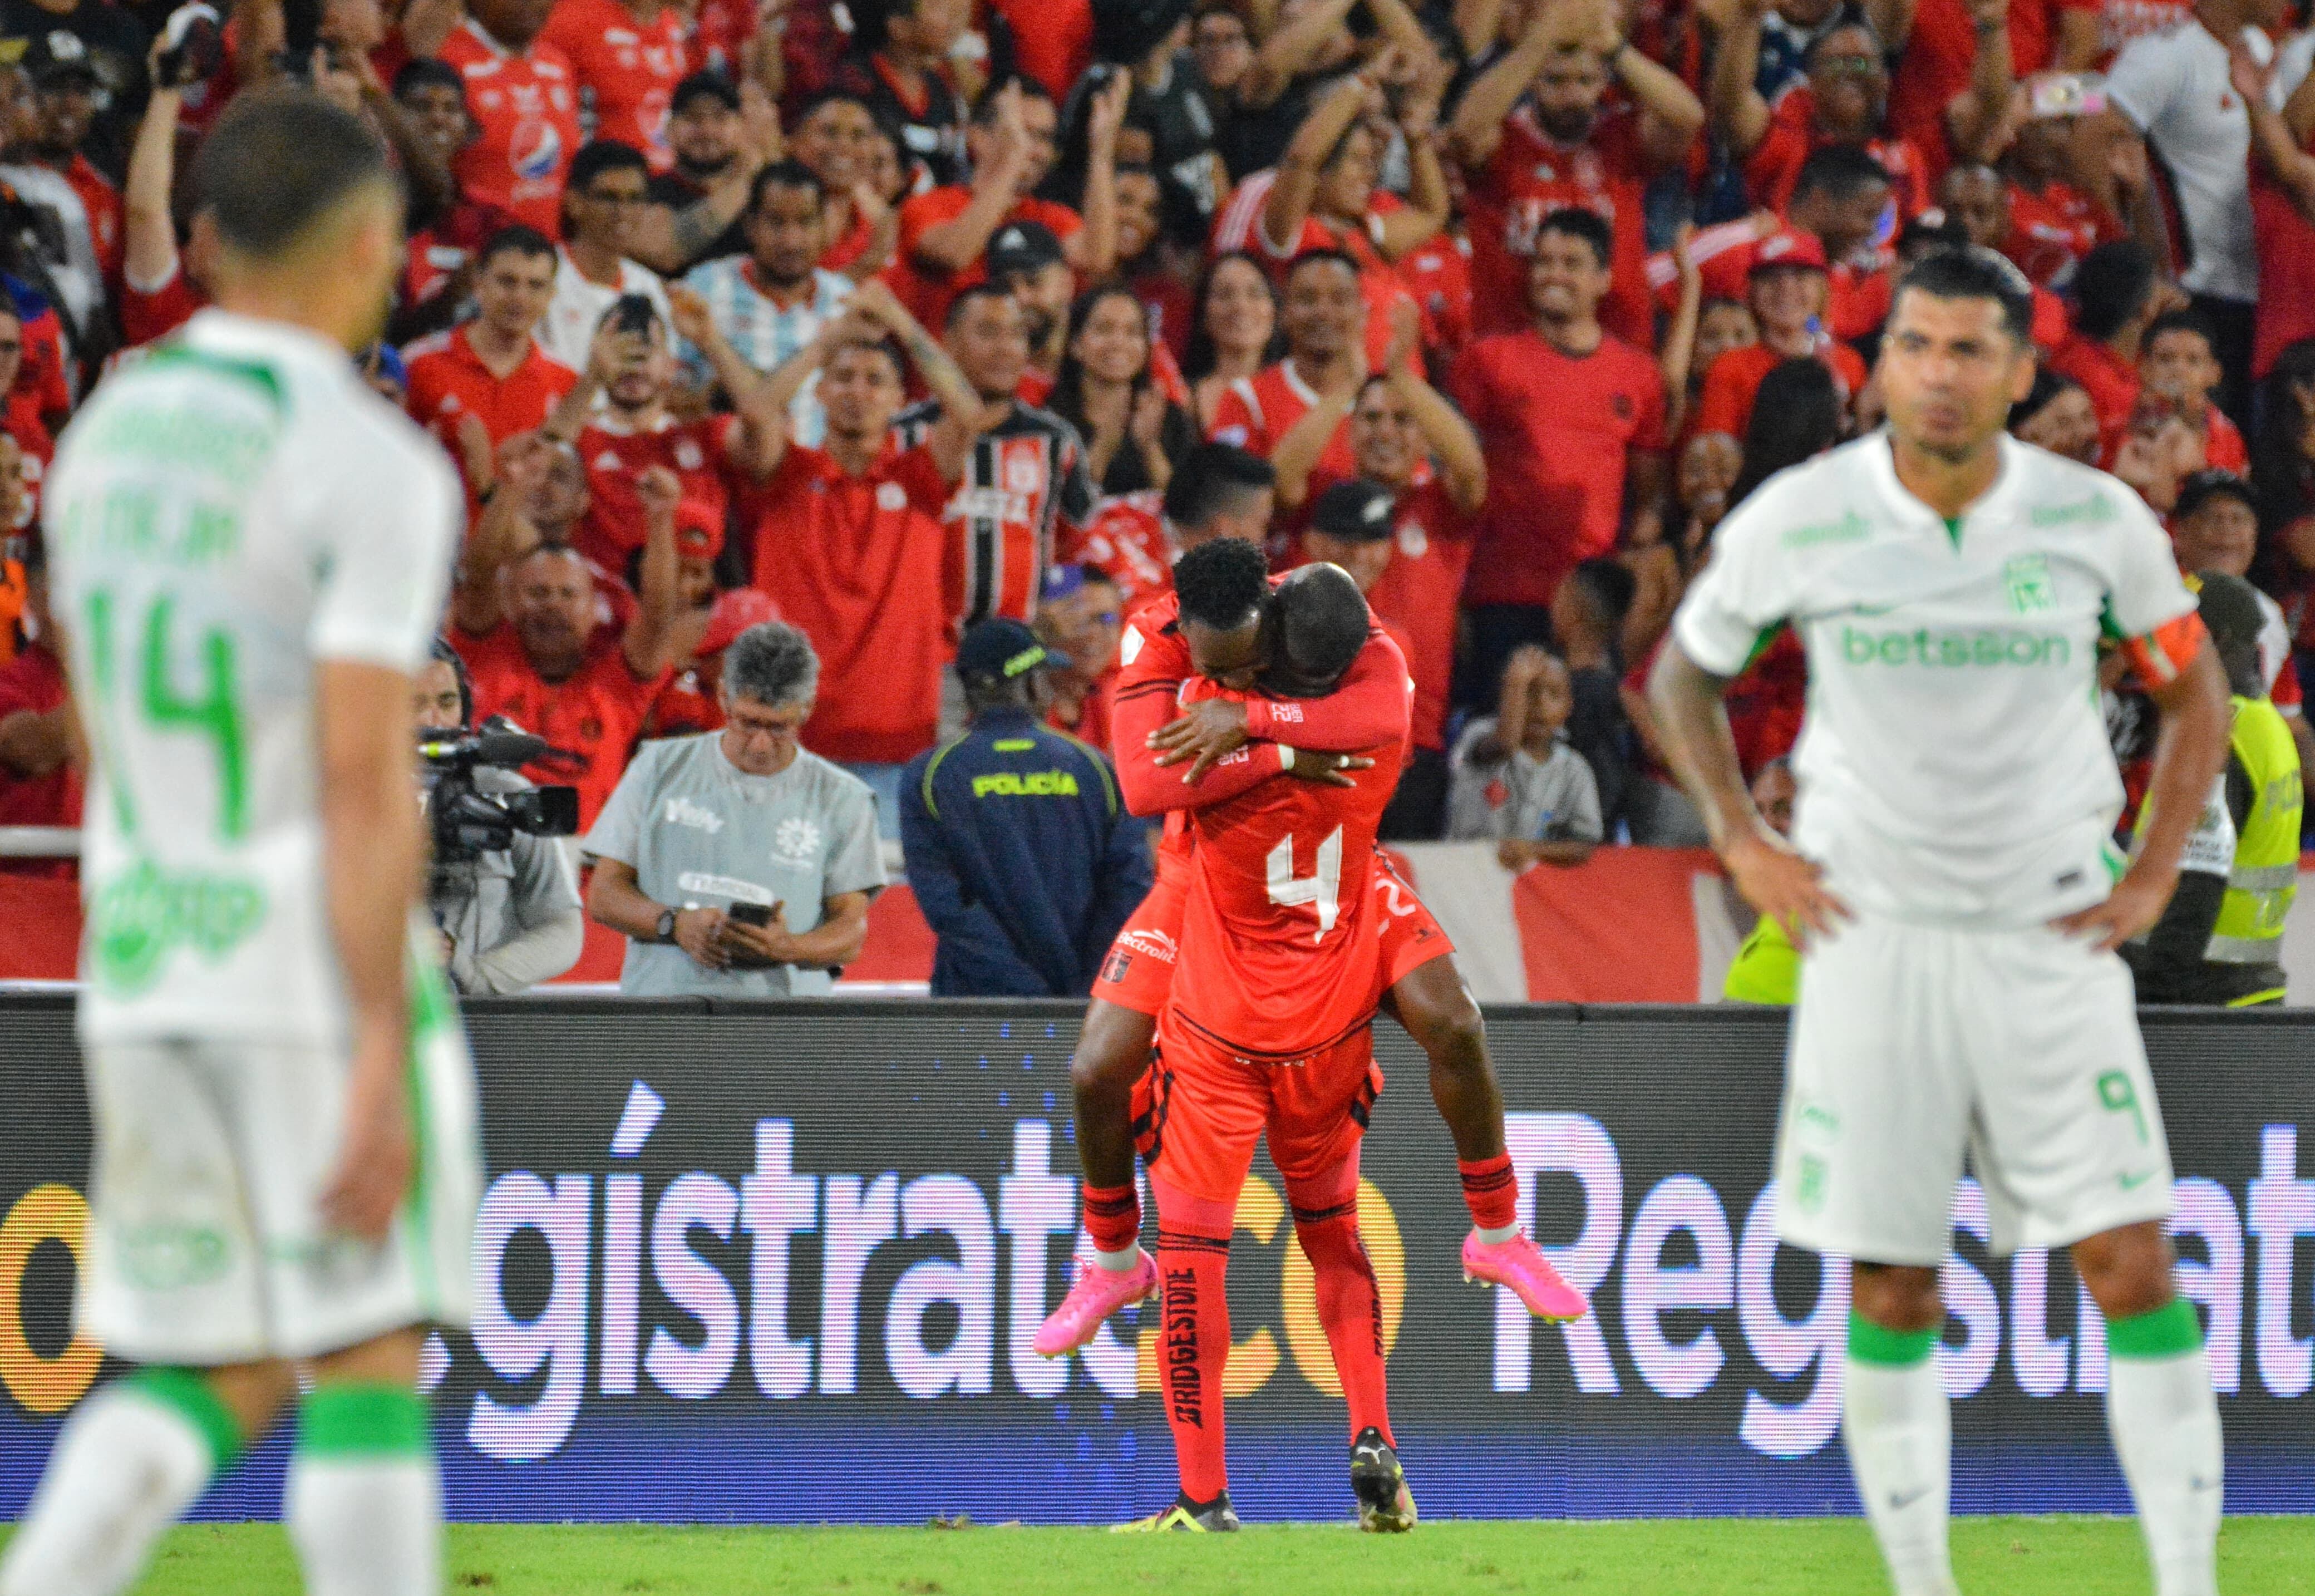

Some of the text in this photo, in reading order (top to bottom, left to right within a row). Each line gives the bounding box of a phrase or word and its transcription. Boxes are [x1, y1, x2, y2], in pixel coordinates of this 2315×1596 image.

[1841, 624, 2072, 667] betsson
[83, 584, 249, 843] 14
[972, 769, 1078, 798] POLICÍA
[1267, 822, 1343, 945] 4
[1116, 931, 1176, 965] Electrolit
[2096, 1067, 2150, 1147] 9
[1165, 1268, 1203, 1429] BRIDGESTONE
